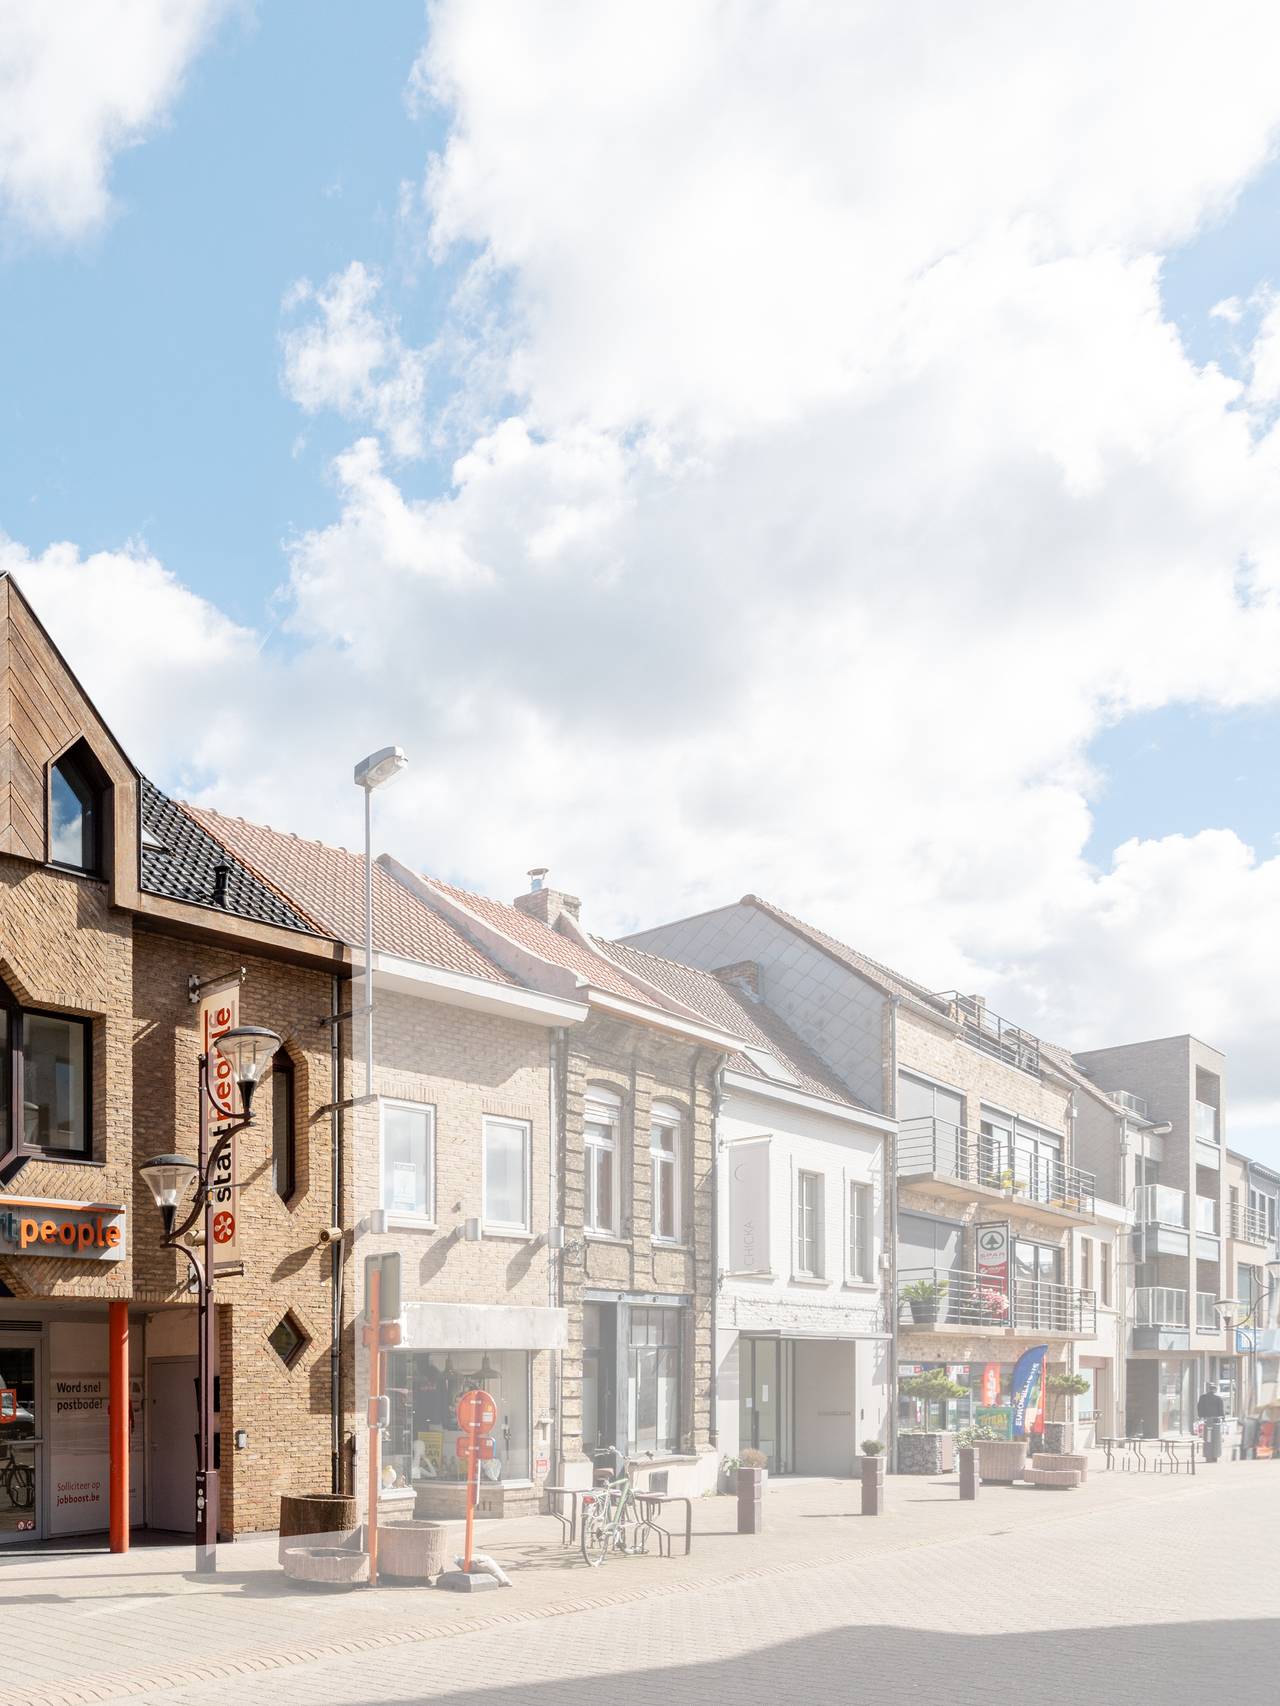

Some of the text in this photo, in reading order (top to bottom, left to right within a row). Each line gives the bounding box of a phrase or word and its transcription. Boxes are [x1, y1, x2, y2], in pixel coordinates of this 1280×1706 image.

[56, 1381, 101, 1393] Word snel
[57, 1398, 103, 1413] postbode!
[57, 1482, 101, 1491] Solliciteer op
[57, 1493, 100, 1507] jobboost.be
